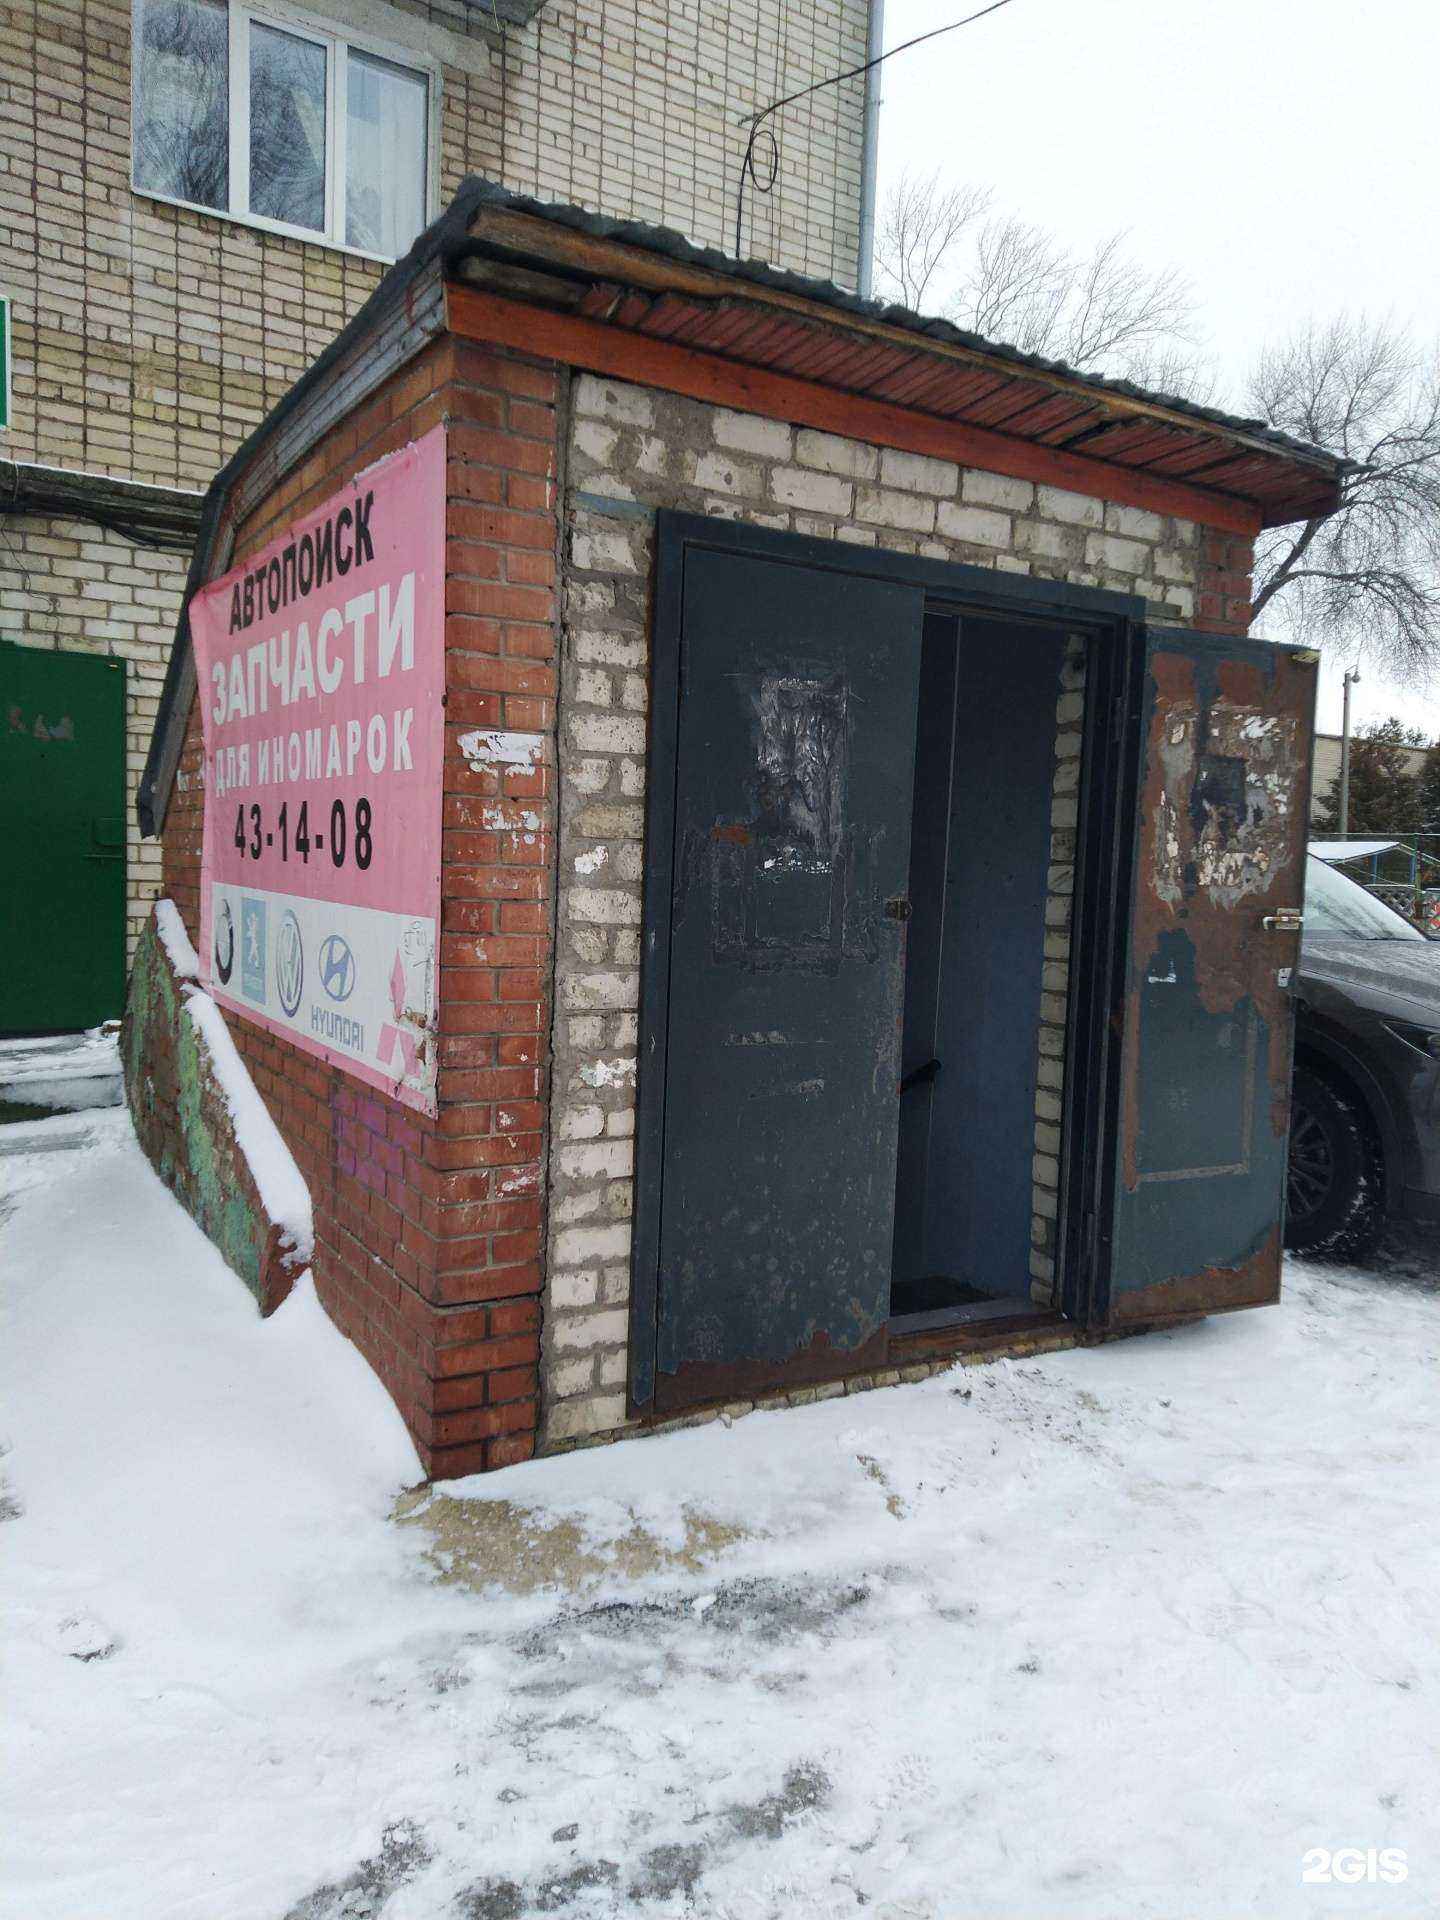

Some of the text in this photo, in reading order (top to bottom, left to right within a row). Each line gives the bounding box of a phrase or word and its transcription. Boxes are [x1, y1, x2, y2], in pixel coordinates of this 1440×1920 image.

[229, 490, 374, 635] АВТОПОИСК
[212, 571, 416, 726] ЗАПЧАСТИ
[215, 707, 414, 797] ДЛЯ ИНОМАРОК
[235, 798, 372, 870] 43-14-08
[312, 1006, 364, 1052] HYUNDAI
